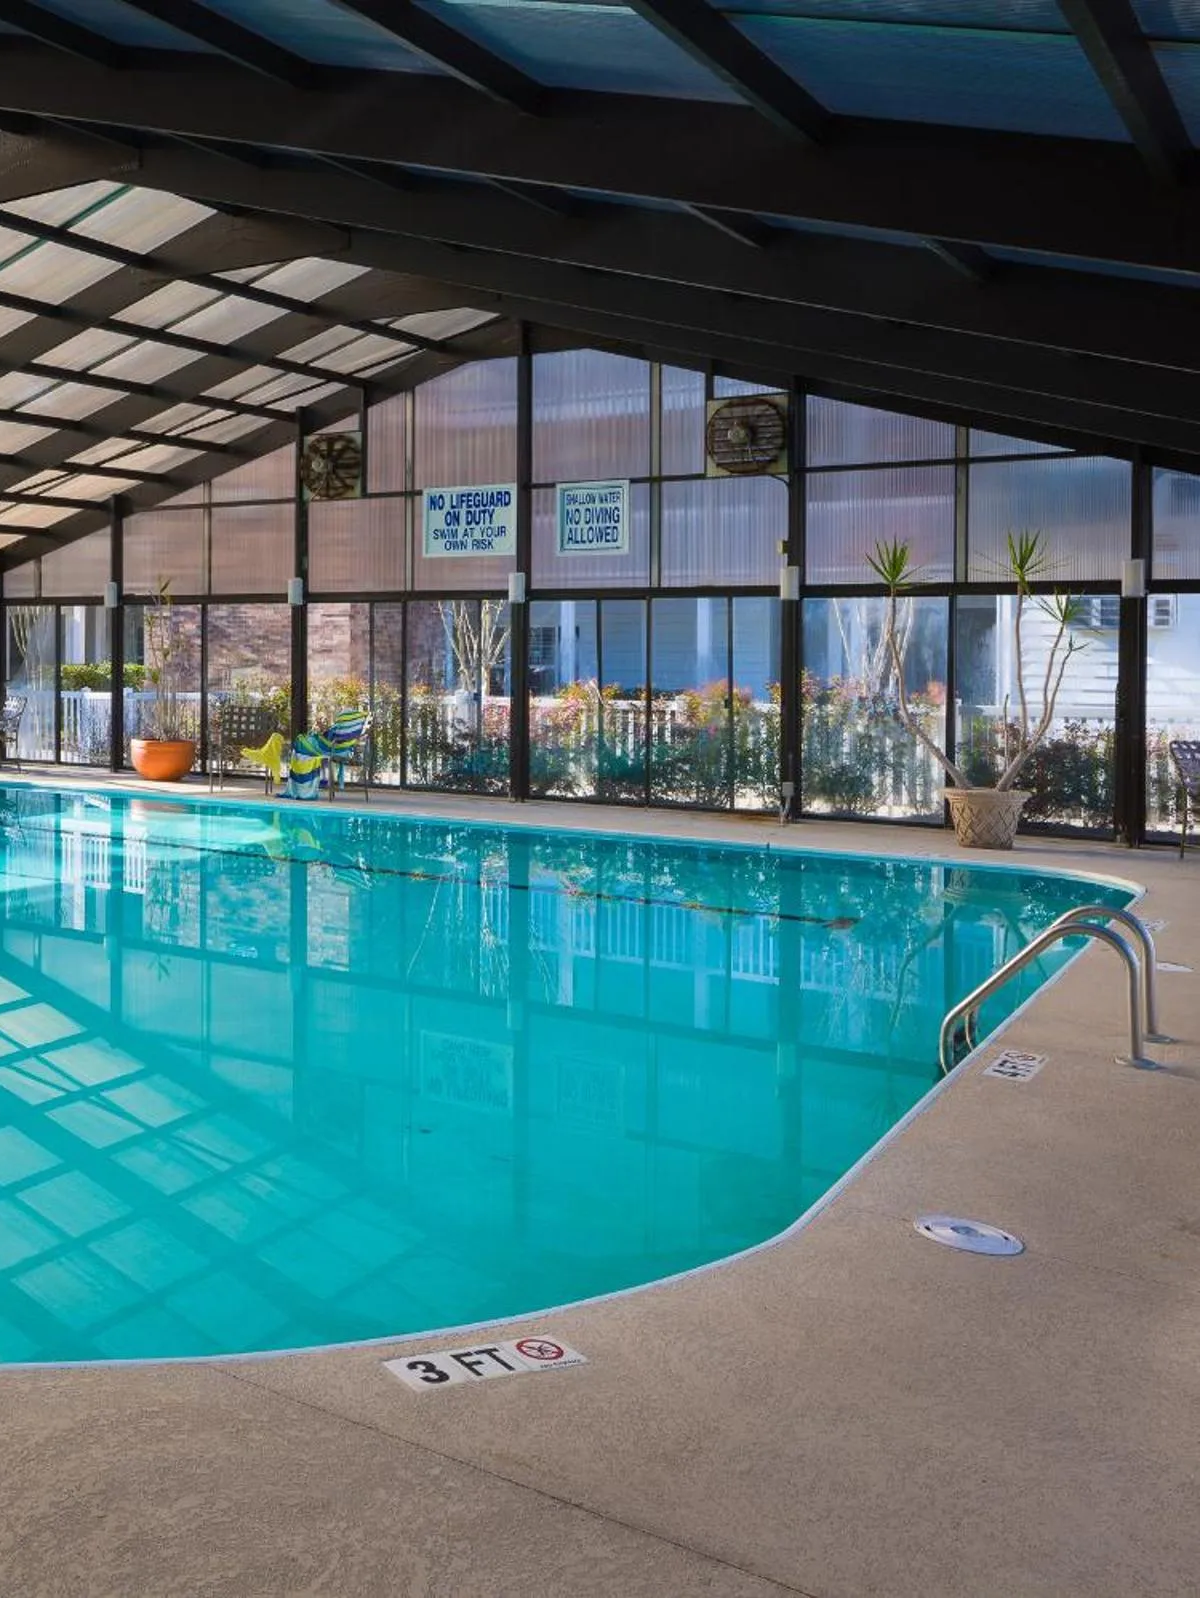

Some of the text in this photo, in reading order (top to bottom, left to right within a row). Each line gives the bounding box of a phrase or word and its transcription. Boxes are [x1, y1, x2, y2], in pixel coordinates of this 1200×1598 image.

[429, 490, 512, 511] NO LIFEGUARD
[444, 508, 496, 527] ON DUTY
[565, 506, 621, 525] NO DIVING
[432, 525, 507, 540] SWIM AT YOUR
[566, 525, 619, 545] ALLOWED
[444, 538, 494, 552] OWN RISK
[406, 1360, 450, 1384] 3
[450, 1347, 516, 1377] FT
